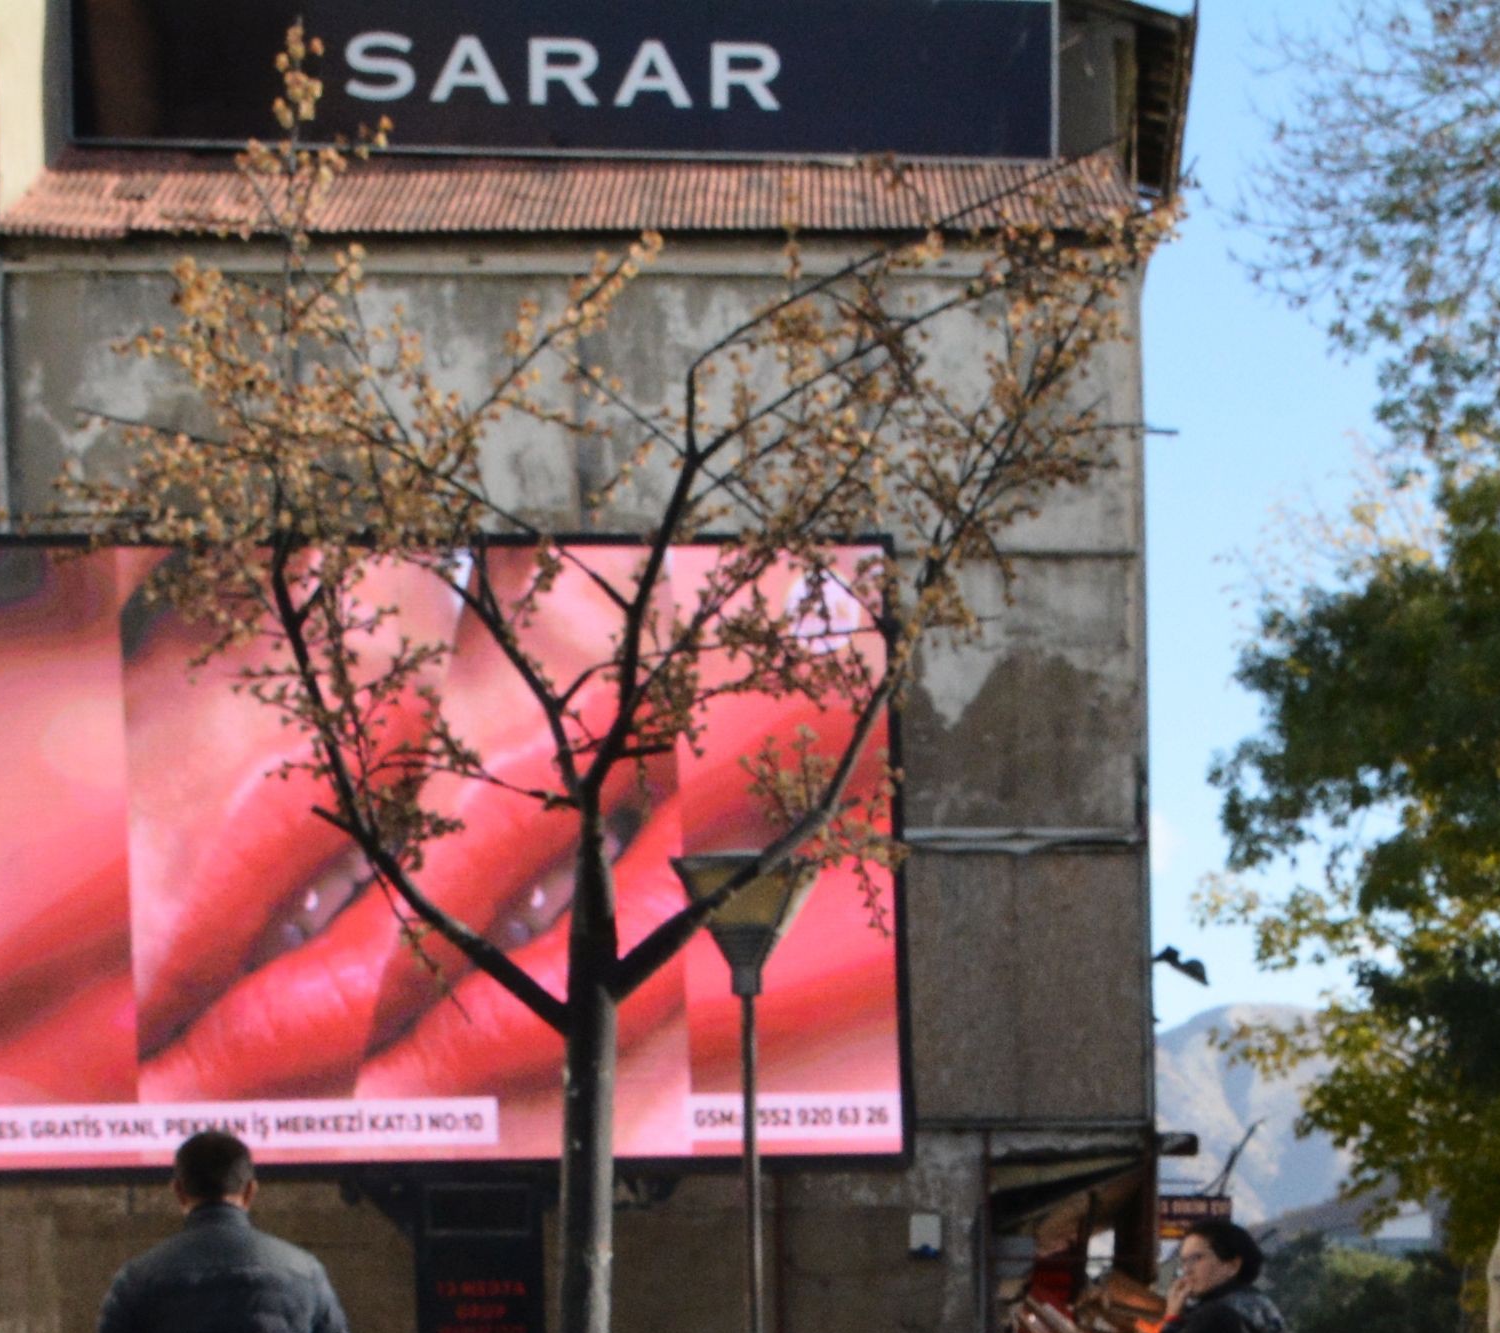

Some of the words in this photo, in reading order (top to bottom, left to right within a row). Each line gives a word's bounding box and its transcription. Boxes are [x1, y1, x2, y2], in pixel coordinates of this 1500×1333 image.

[344, 31, 782, 111] SARAR
[30, 1114, 101, 1138] GRATİS
[275, 1110, 365, 1134] MERKEZİ
[798, 1107, 833, 1125] 920
[838, 1106, 861, 1125] 63
[867, 1106, 889, 1124] 26
